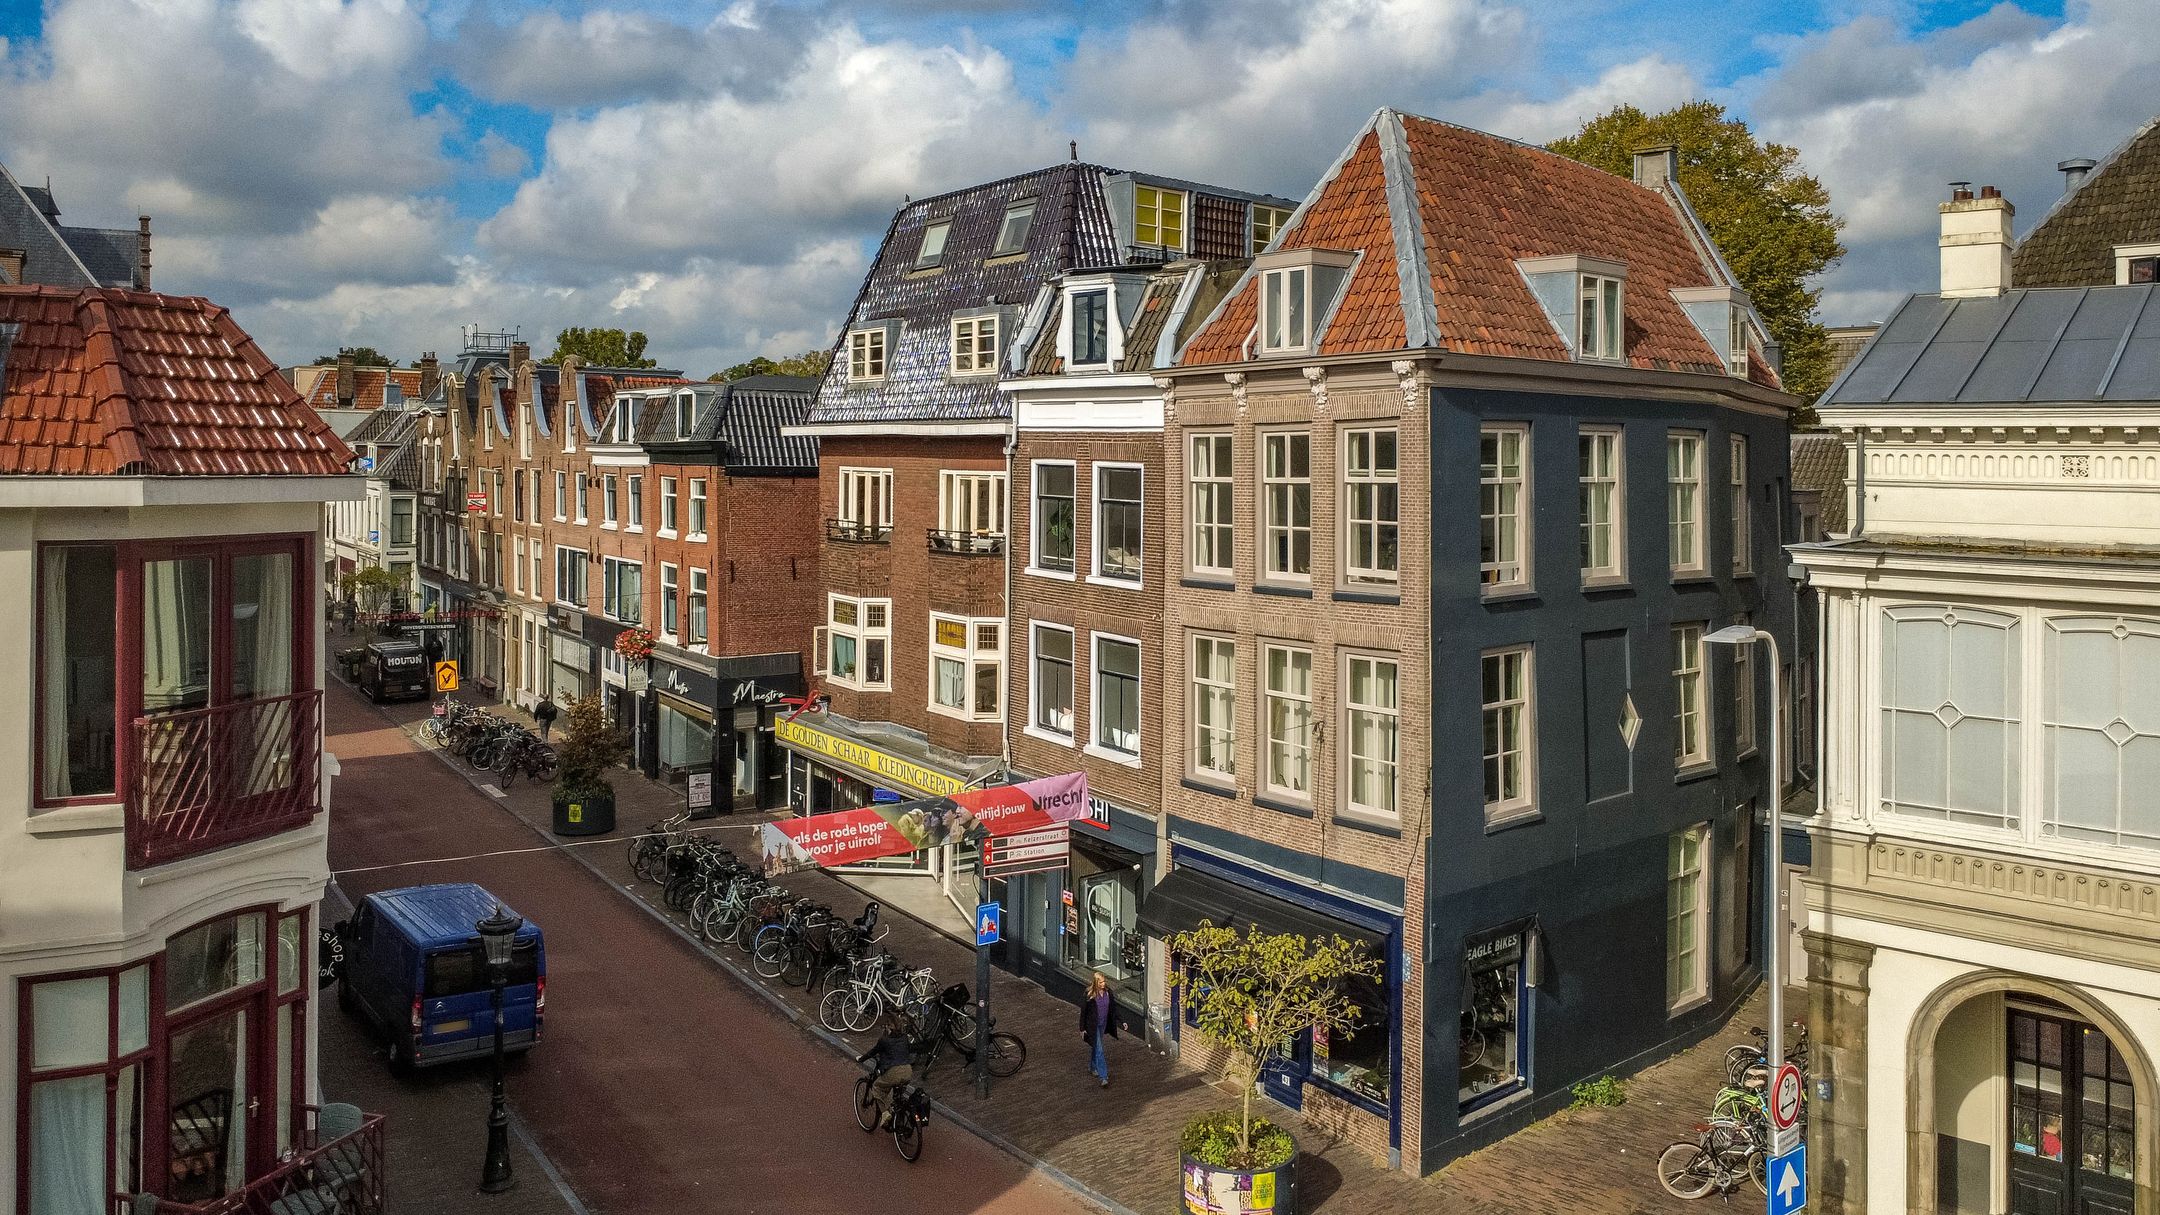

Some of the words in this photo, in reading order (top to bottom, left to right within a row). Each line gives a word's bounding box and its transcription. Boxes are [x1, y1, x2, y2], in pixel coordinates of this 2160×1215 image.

[732, 680, 785, 705] Maestro
[778, 721, 790, 736] DE
[792, 726, 829, 752] GOUDEN
[832, 739, 871, 767] SCHAAR
[877, 755, 965, 796] KLEDINGREPARA
[975, 807, 1001, 821] altijd
[1001, 803, 1026, 819] jouw
[792, 831, 811, 846] als
[812, 828, 828, 841] de
[830, 824, 857, 839] rode
[858, 820, 888, 836] loper
[1023, 833, 1059, 844] Keizerstraat
[805, 842, 833, 856] voor
[835, 840, 846, 855] je
[847, 834, 882, 850] uitrolt
[1023, 847, 1045, 857] Station
[1467, 942, 1493, 961] EAGLE
[1494, 934, 1517, 952] BIKES
[1784, 1078, 1790, 1097] 9
